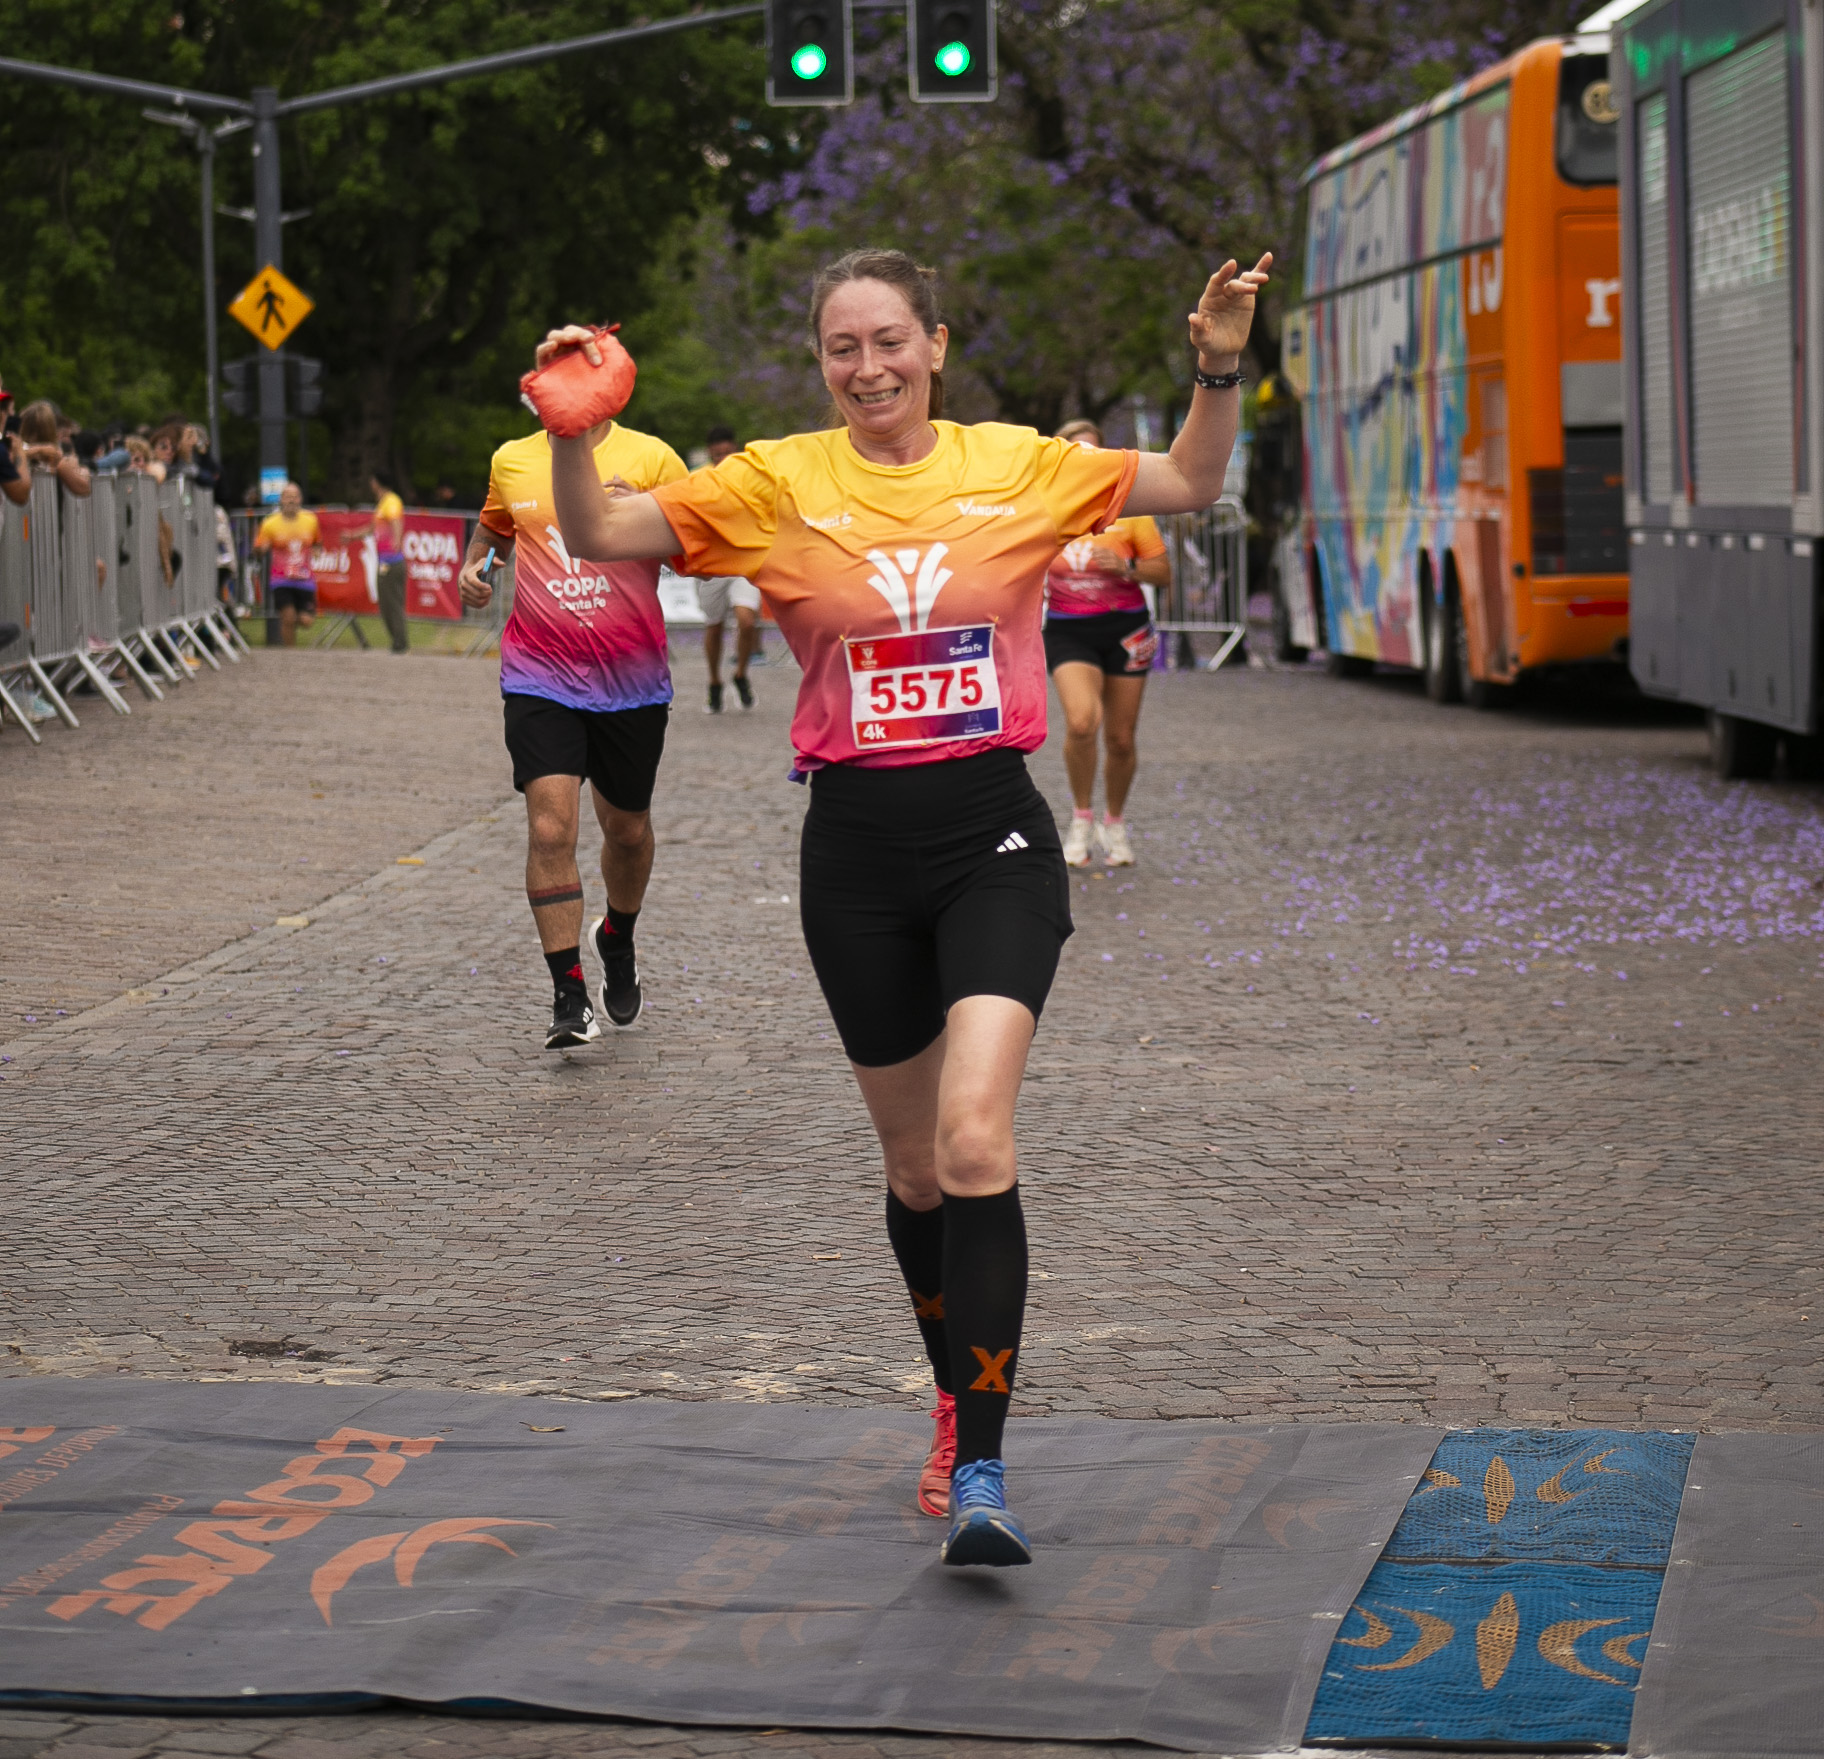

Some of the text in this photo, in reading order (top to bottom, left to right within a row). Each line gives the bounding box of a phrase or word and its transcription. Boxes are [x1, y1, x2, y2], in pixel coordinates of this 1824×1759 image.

[404, 531, 459, 564] COPA
[546, 575, 612, 597] COPA
[592, 596, 607, 608] Fe
[949, 643, 983, 656] Santa Fe
[870, 665, 983, 715] 5575
[862, 723, 887, 740] 4k
